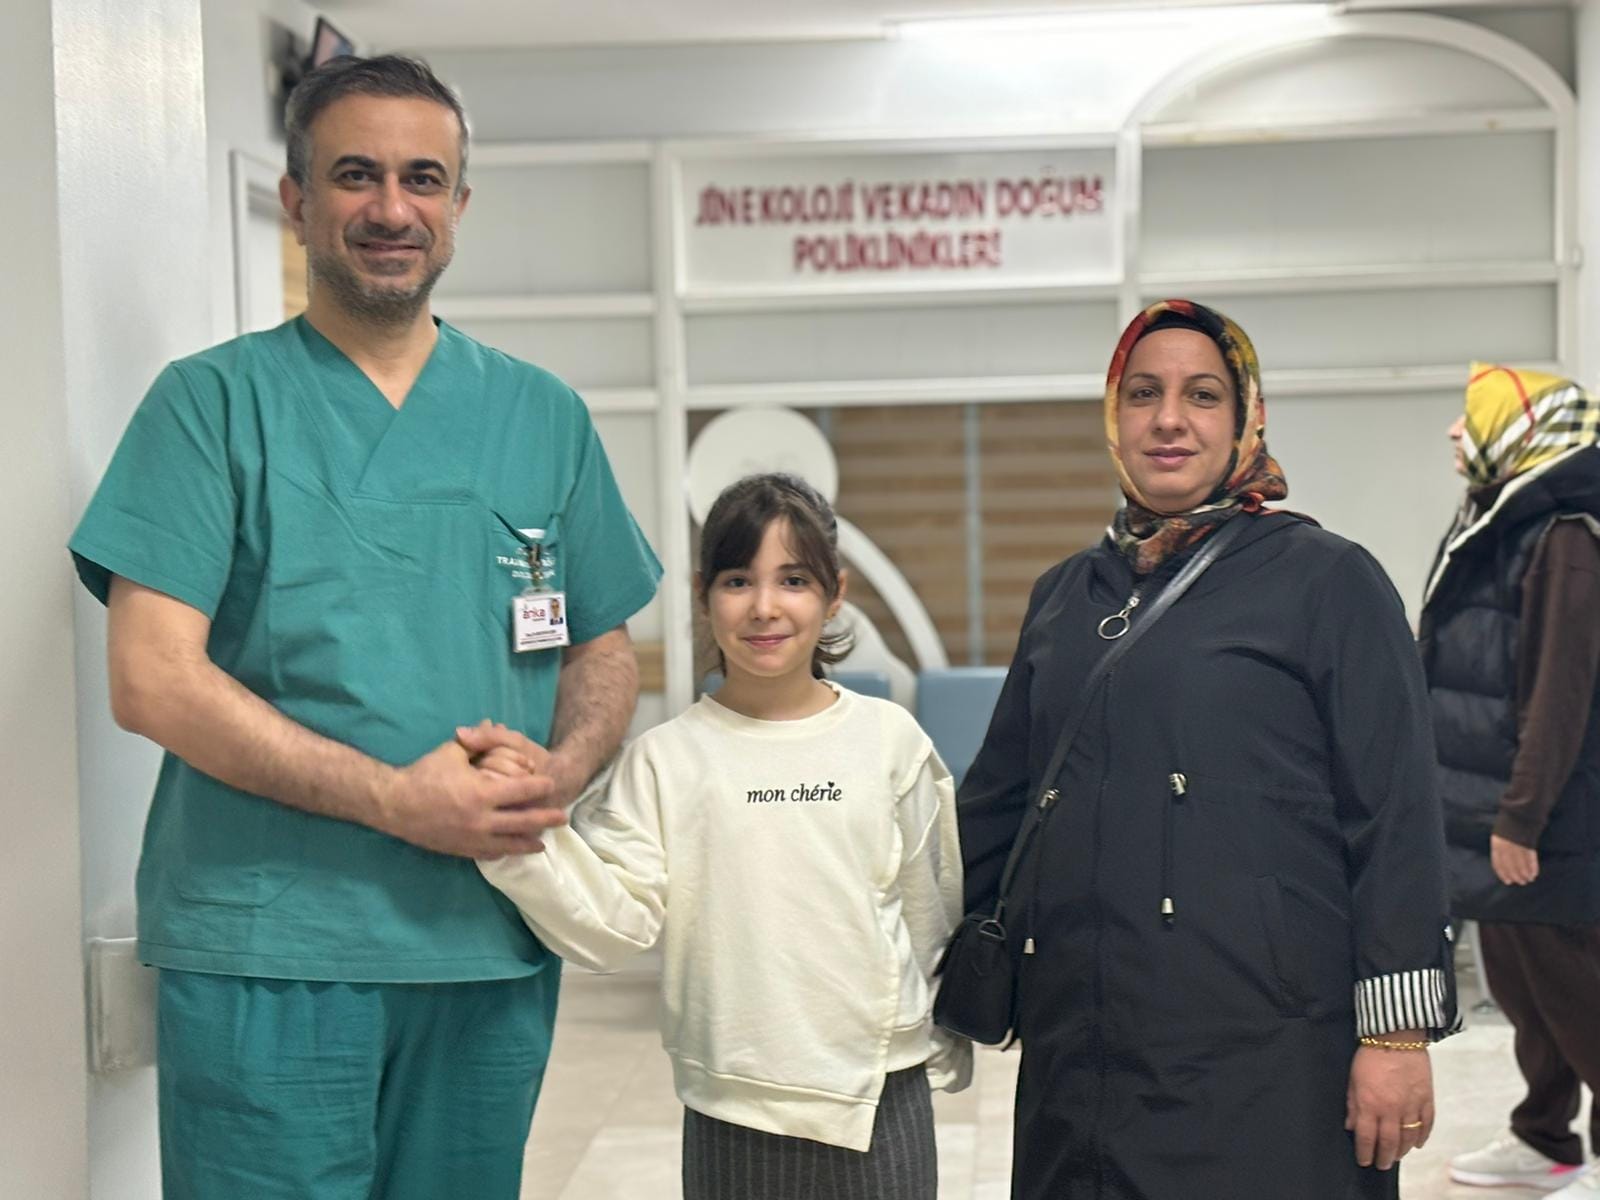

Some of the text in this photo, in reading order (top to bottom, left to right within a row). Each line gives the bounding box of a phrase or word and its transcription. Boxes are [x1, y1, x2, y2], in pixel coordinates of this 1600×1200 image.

[996, 166, 1104, 218] DOĞUM
[746, 781, 843, 803] mon chérie
